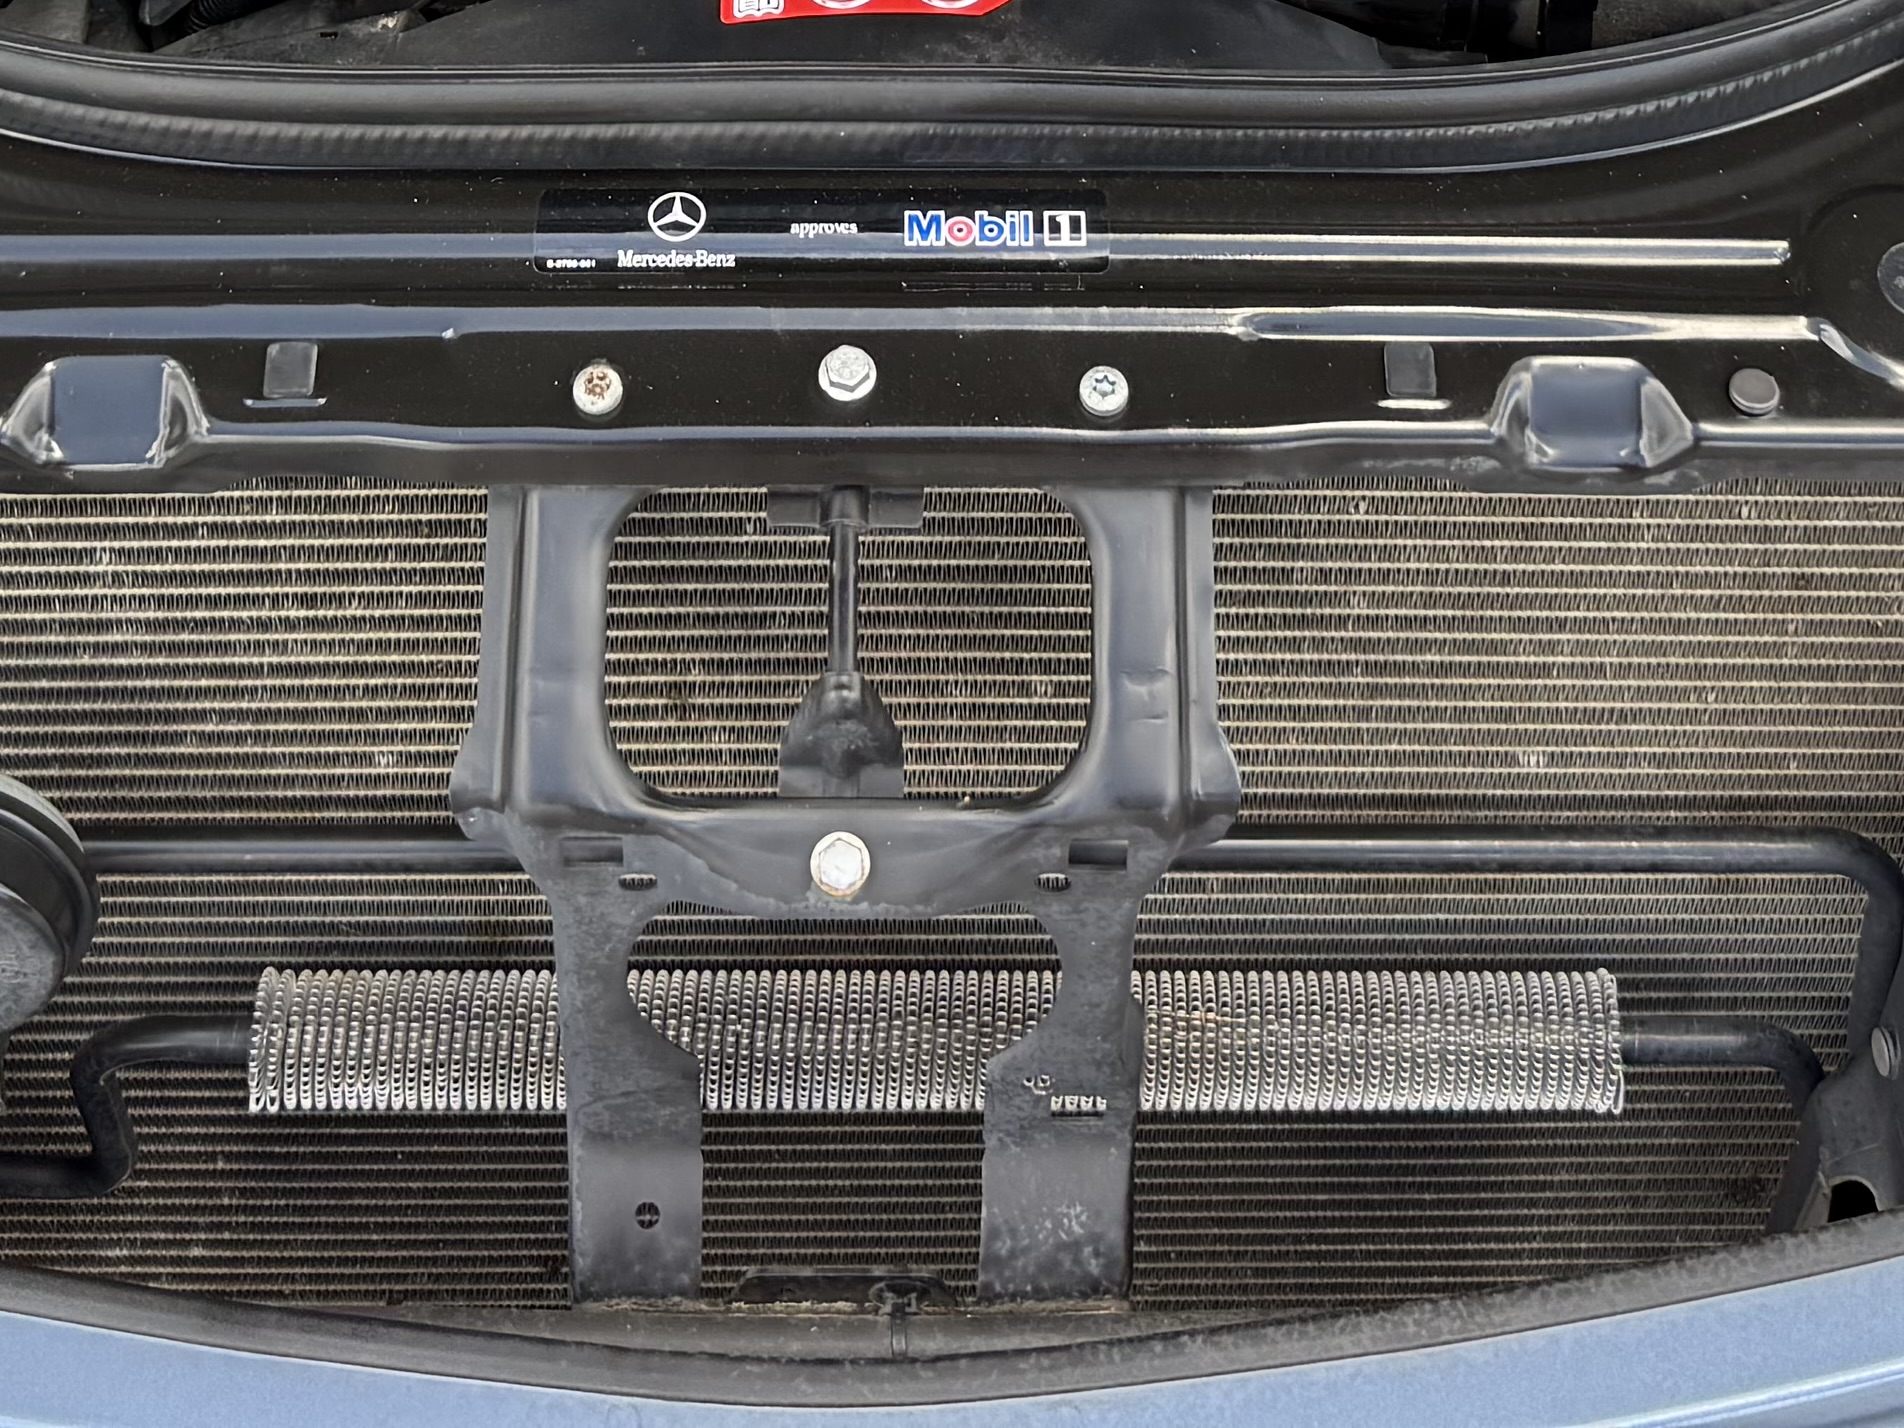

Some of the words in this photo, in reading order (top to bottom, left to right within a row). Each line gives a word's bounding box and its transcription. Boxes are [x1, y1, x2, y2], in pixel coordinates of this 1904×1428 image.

[790, 220, 859, 238] approves
[903, 209, 1034, 247] Mobil
[617, 249, 736, 268] Mercedes-Benz
